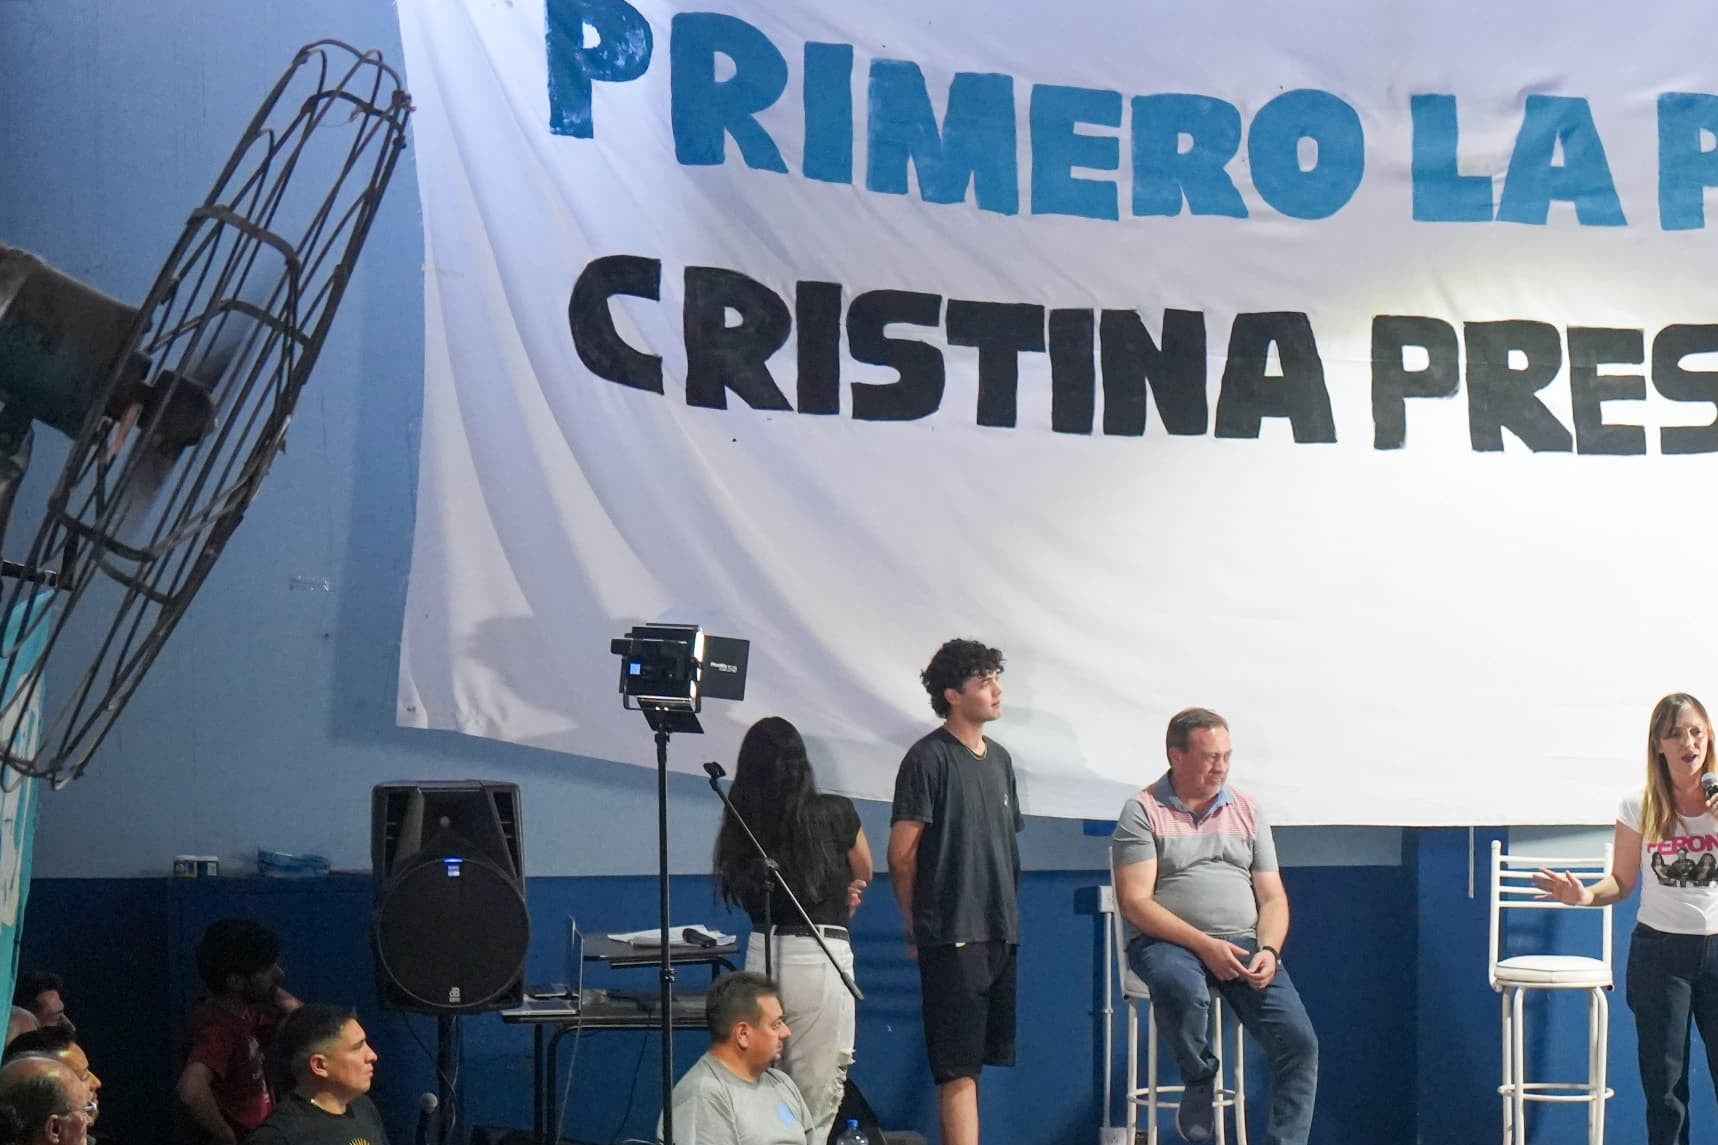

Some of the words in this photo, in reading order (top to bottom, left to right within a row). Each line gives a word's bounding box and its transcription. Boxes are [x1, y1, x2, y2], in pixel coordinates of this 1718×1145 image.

[545, 0, 1364, 220] PRIMERO
[1411, 93, 1628, 226] LA
[568, 254, 1337, 443] CRISTINA
